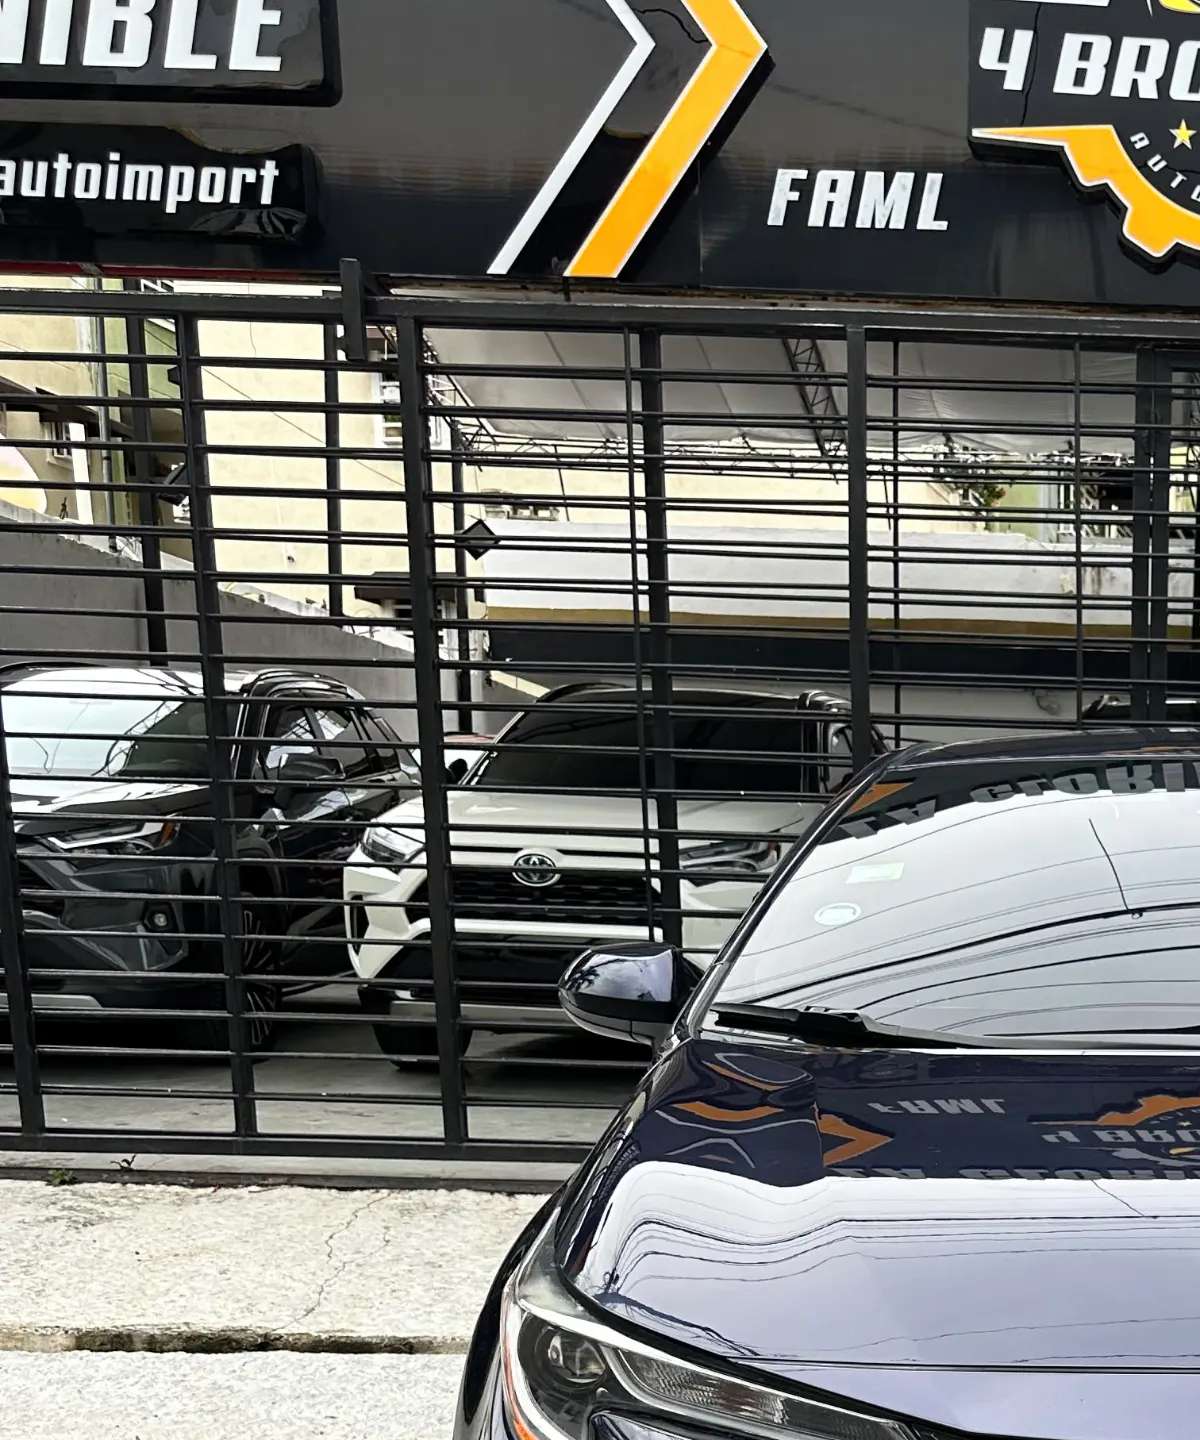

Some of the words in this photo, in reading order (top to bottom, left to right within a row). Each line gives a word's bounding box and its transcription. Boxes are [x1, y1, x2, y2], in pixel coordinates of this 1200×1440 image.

[977, 27, 1034, 91] 4
[0, 152, 279, 213] autoimport
[765, 168, 949, 232] FAML
